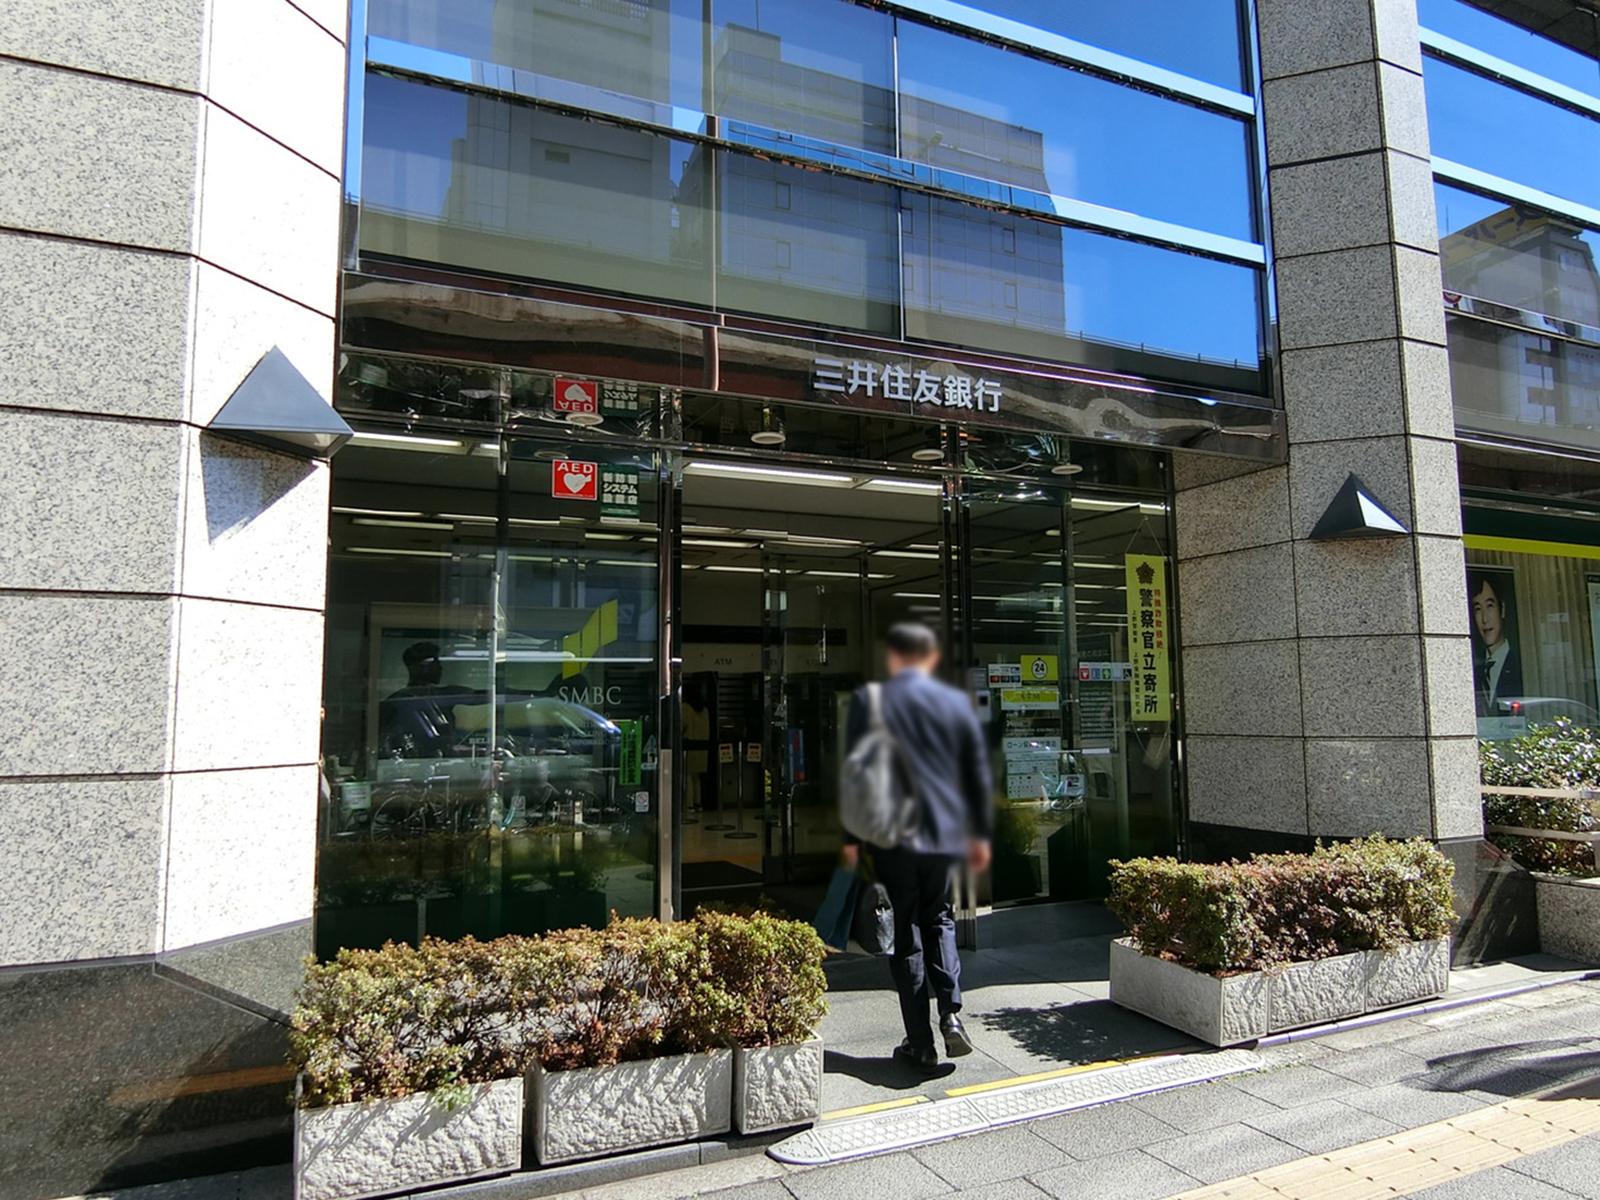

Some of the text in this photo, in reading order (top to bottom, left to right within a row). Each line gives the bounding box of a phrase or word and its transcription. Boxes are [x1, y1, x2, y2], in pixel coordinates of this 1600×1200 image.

[813, 358, 1003, 413] 三井住友銀行
[557, 462, 593, 474] AED
[602, 484, 638, 495] システム
[1139, 588, 1158, 714] 警察官立寄所
[714, 658, 733, 666] ATM
[1034, 663, 1045, 673] 24
[558, 686, 622, 706] SMBC
